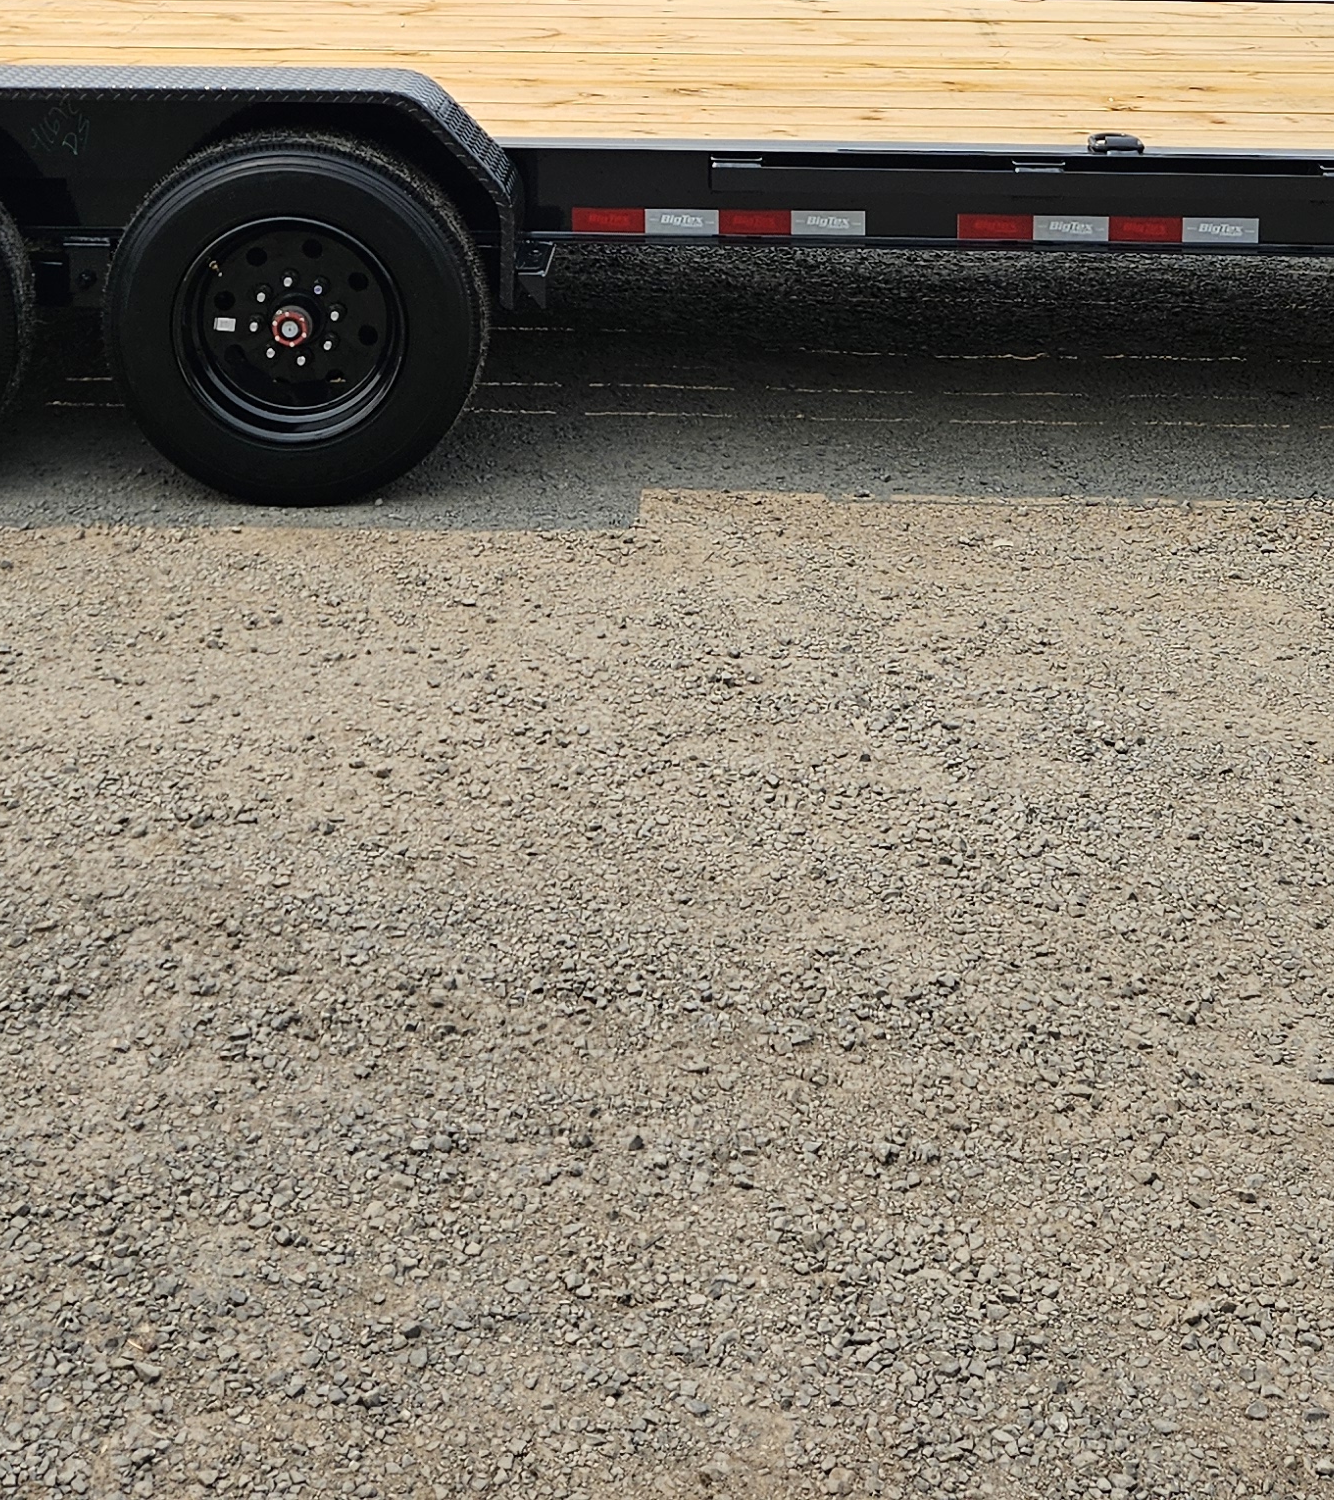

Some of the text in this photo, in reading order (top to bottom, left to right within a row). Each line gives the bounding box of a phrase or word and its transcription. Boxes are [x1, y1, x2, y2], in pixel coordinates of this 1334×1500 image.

[660, 214, 703, 226] BigTex
[806, 216, 849, 227] BigTex
[1049, 221, 1092, 233] BigTex
[1198, 223, 1242, 235] BigTex
